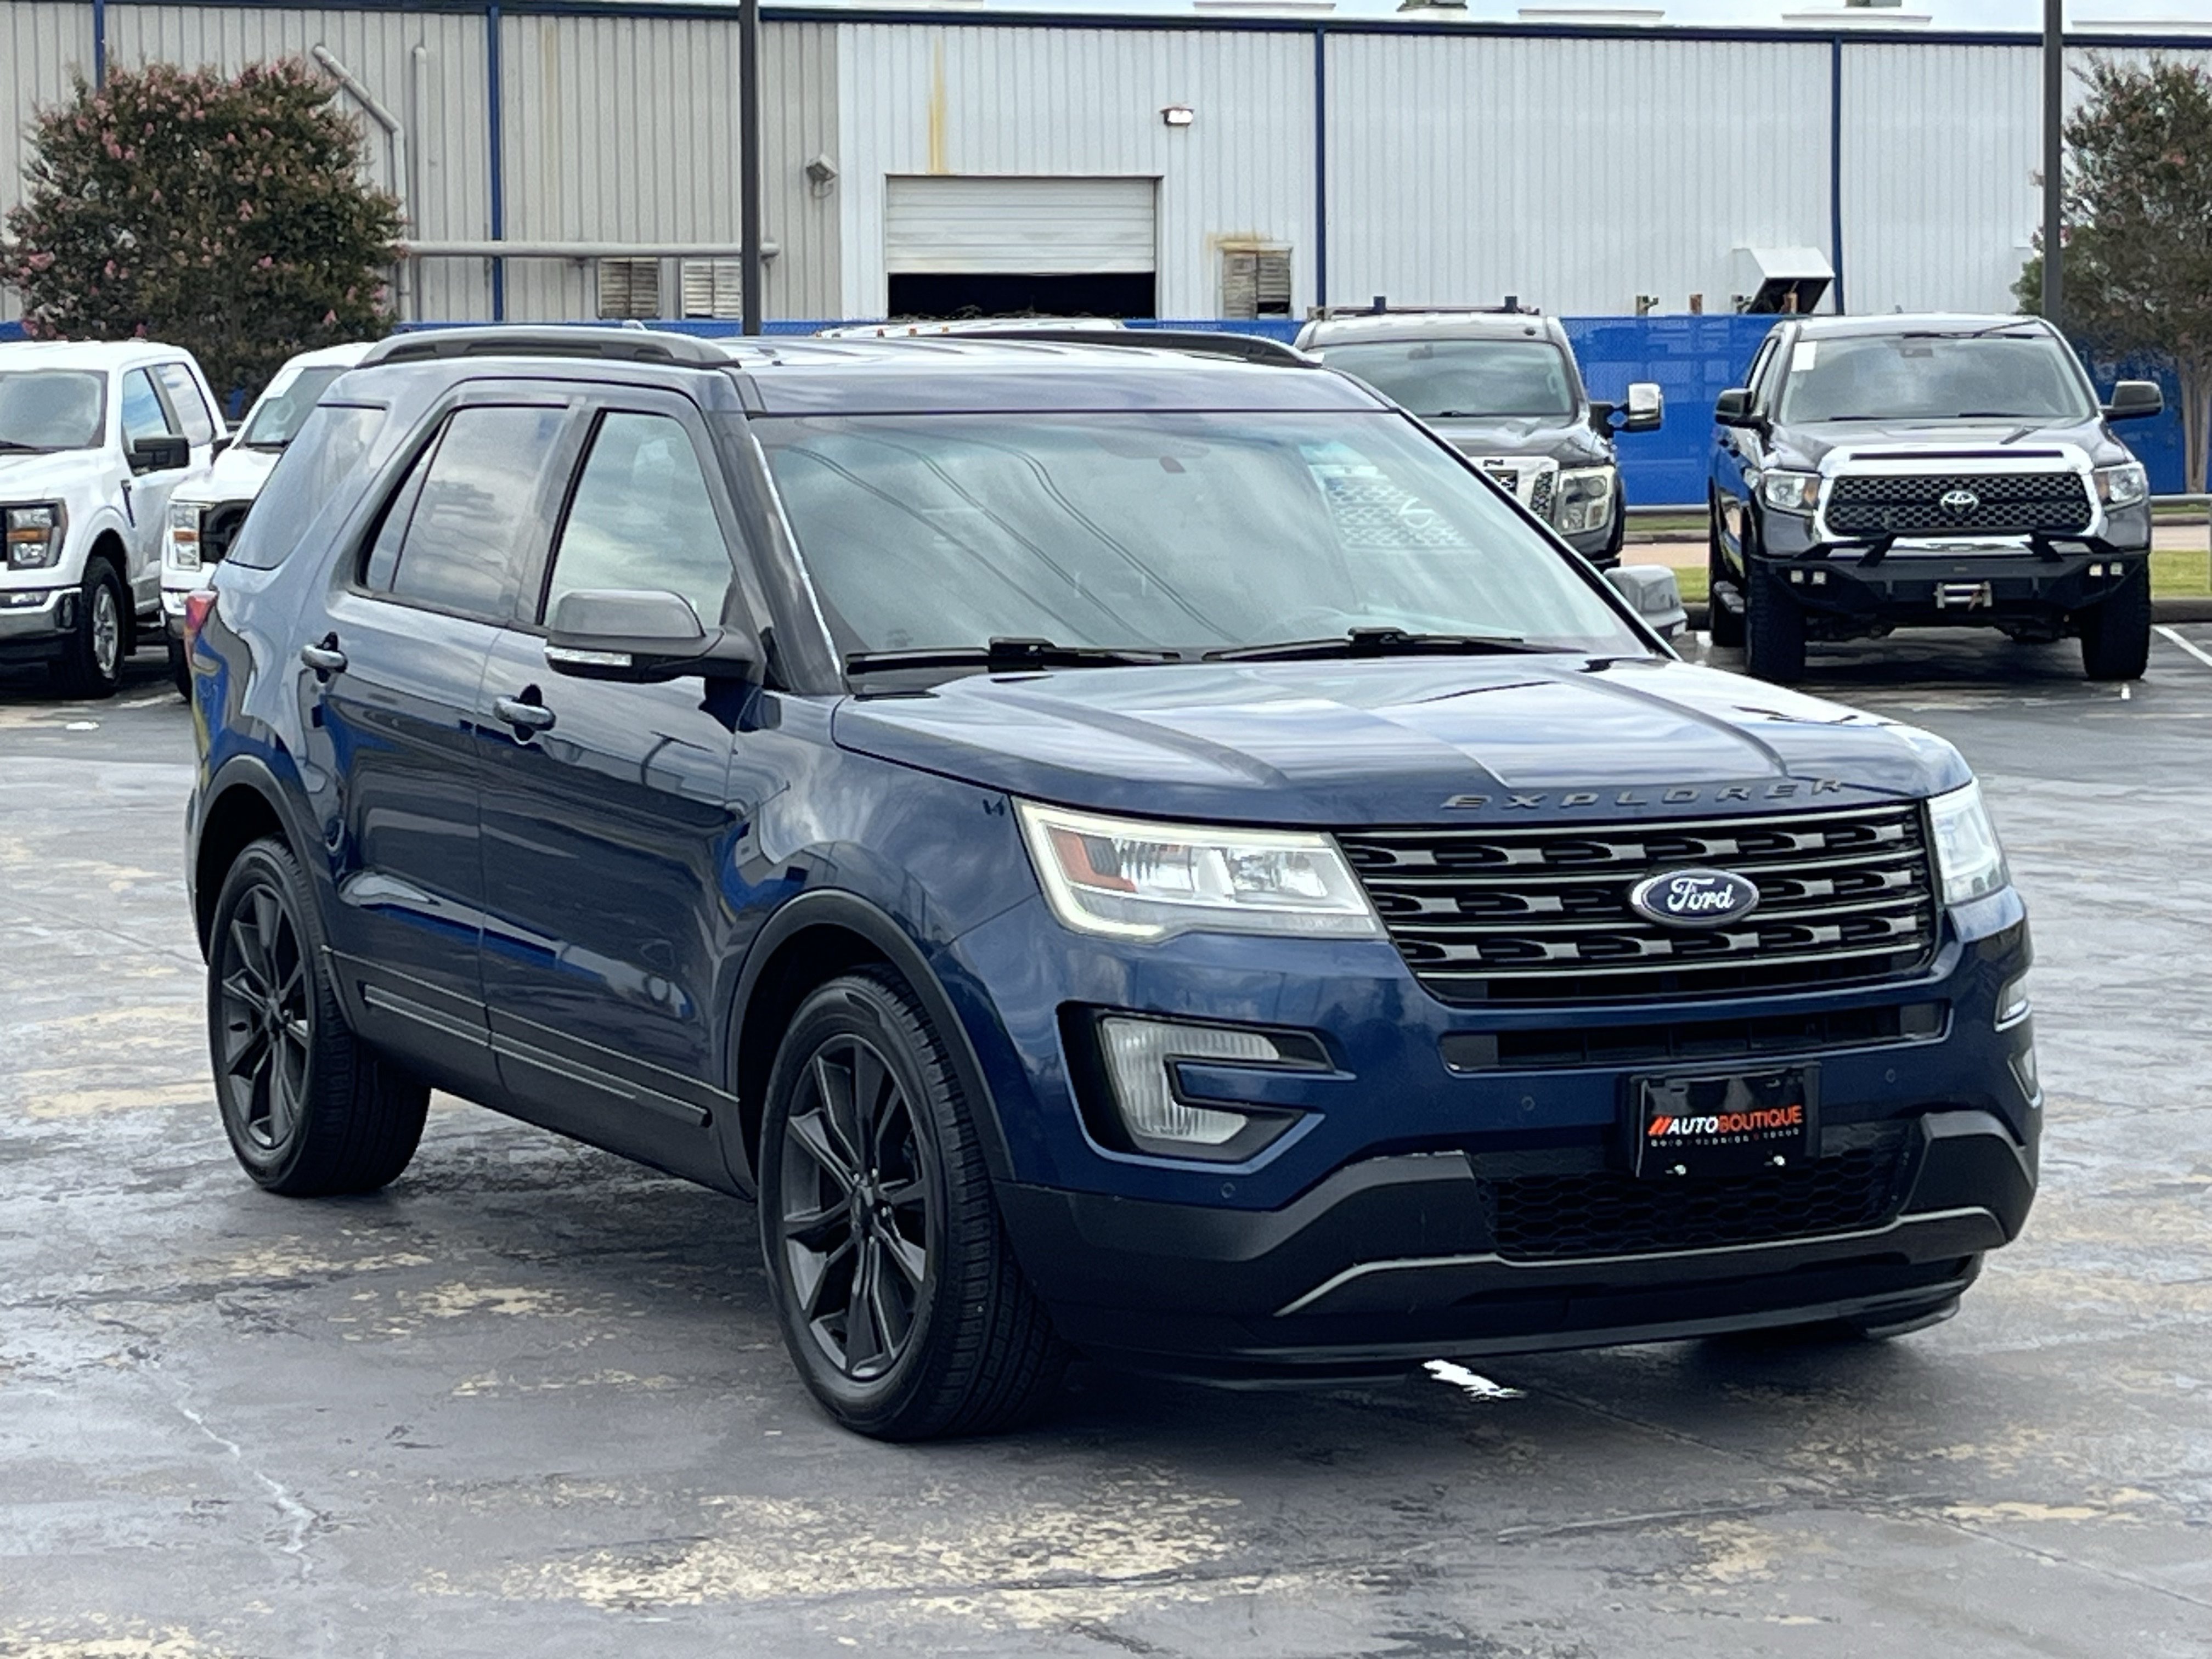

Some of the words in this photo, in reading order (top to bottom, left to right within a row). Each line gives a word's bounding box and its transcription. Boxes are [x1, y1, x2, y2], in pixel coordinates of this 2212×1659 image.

[1440, 774, 1842, 809] EXPLORER
[1667, 877, 1735, 912] Ford
[1667, 1104, 1803, 1135] AUTOBOUTIQUE
